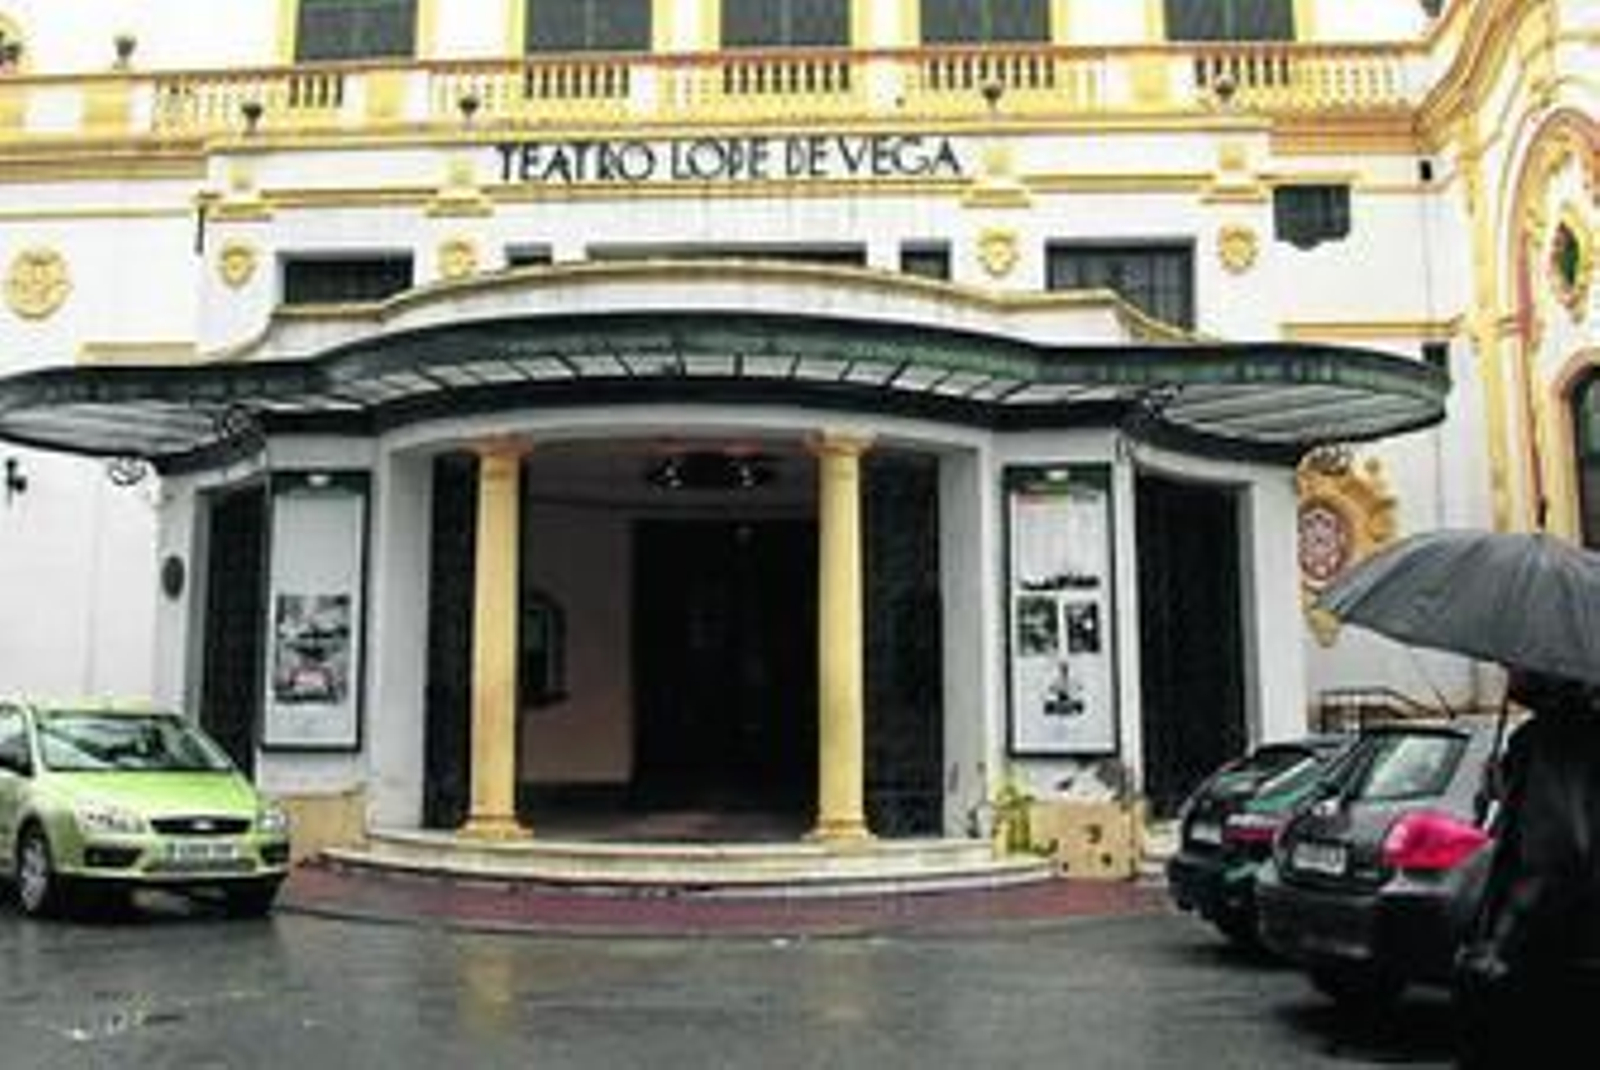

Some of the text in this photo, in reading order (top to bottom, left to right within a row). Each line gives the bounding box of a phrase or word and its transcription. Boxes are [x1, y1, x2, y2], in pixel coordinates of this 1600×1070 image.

[496, 135, 962, 184] TEATRO LOPE DE VEGA
